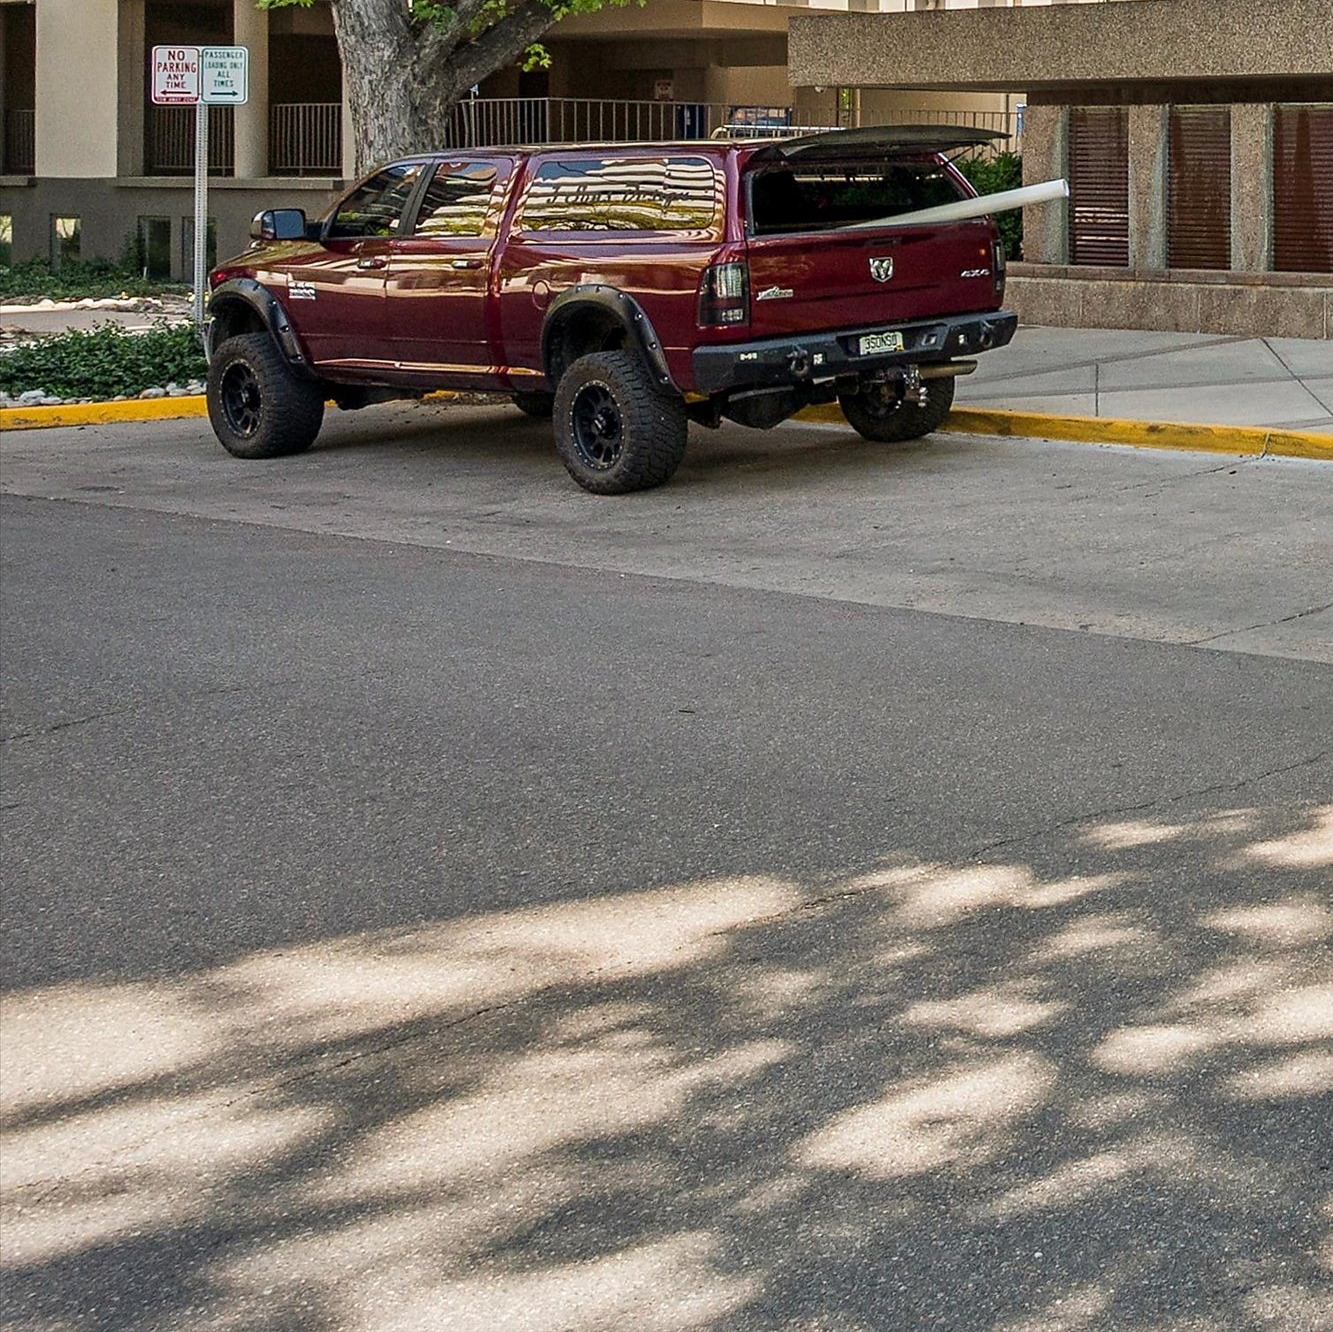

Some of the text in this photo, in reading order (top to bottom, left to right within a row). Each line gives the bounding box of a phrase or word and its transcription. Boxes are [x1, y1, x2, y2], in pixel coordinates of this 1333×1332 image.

[167, 50, 185, 61] NO
[204, 51, 243, 59] PASSENGER
[157, 62, 197, 73] PARKING
[217, 70, 230, 78] ALL
[165, 81, 187, 89] TIME
[213, 80, 234, 88] TIMES
